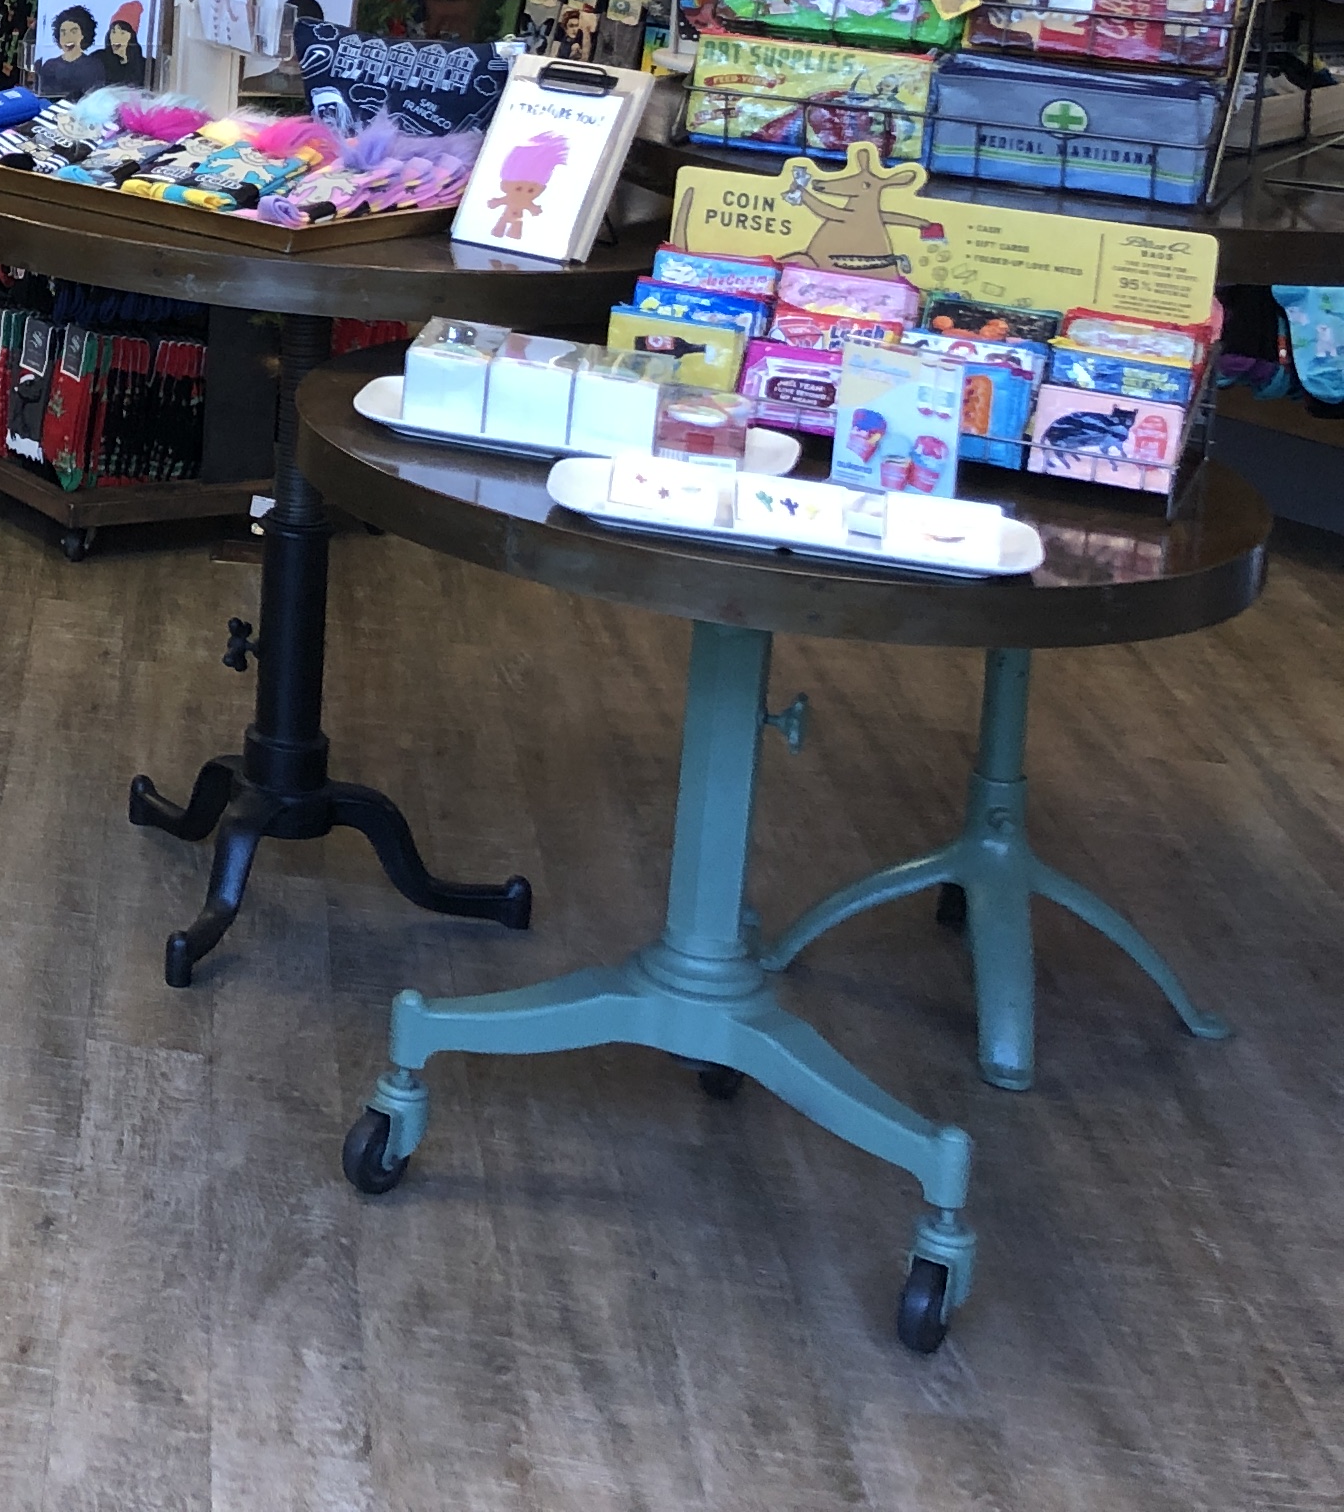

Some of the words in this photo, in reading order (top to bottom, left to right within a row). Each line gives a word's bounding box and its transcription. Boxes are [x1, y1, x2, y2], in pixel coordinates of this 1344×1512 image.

[703, 40, 741, 64] ART
[750, 45, 856, 74] SUPPLIES
[402, 99, 452, 130] FRANCISCO
[420, 97, 439, 110] SAN
[979, 135, 1044, 154] MEDICAL
[723, 191, 775, 213] COIN
[705, 210, 792, 236] PURSES
